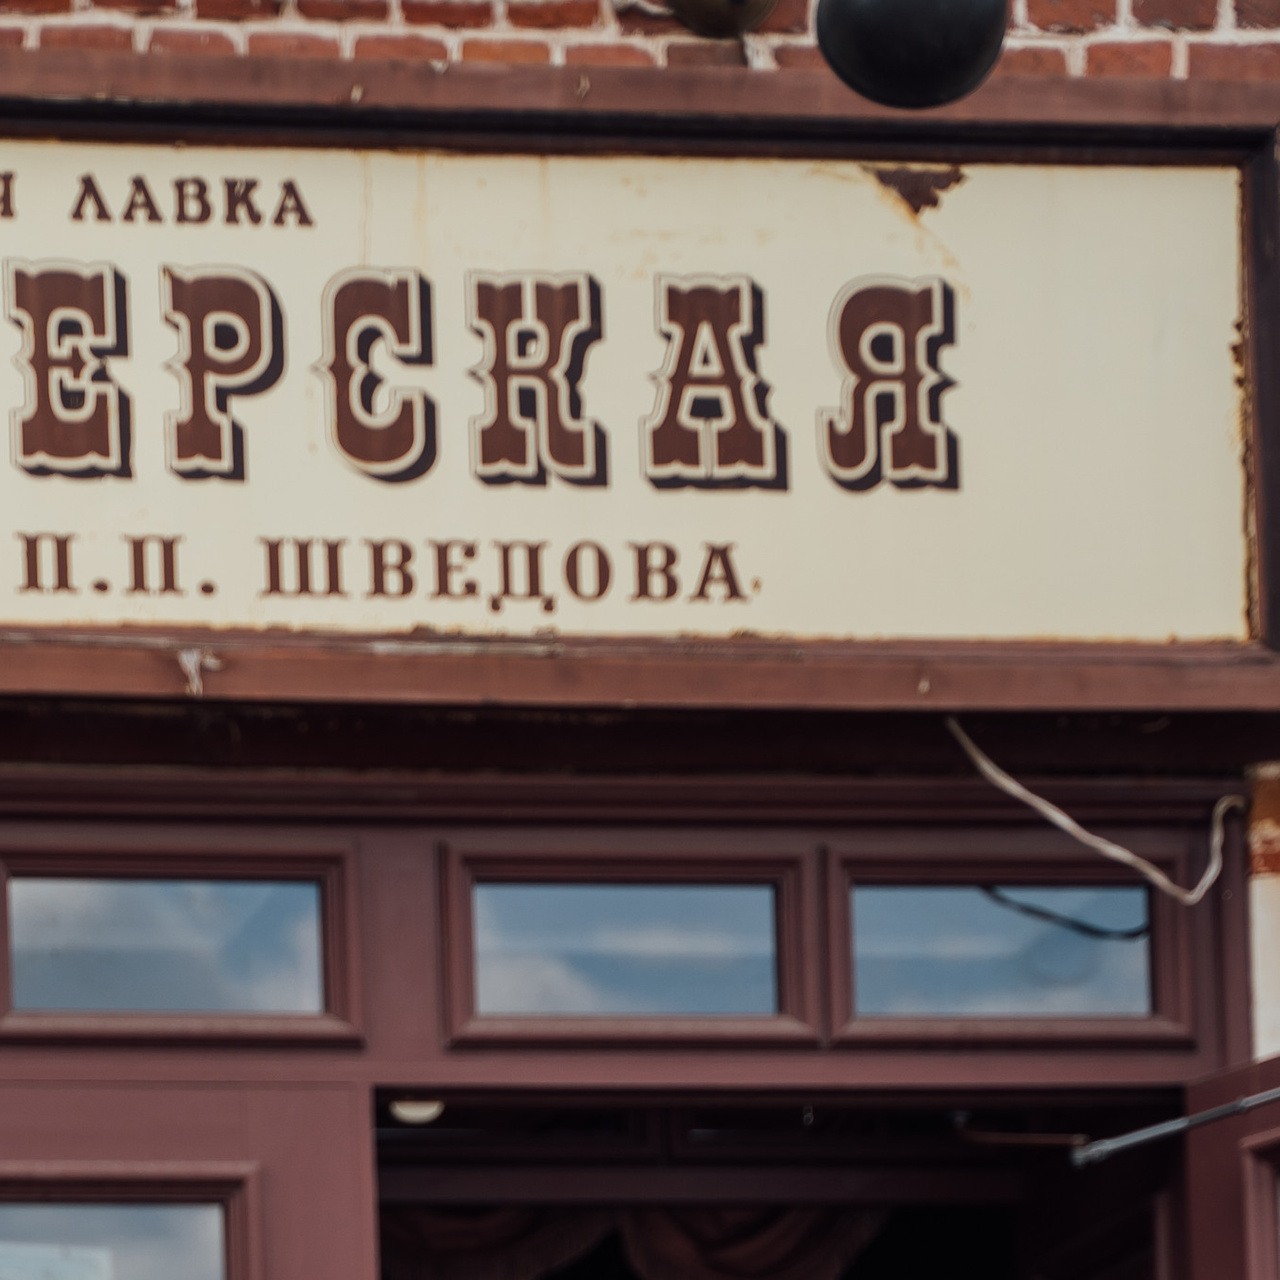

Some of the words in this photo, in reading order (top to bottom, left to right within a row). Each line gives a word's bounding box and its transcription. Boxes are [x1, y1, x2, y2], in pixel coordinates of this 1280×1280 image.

[70, 174, 314, 227] ЛАВКА
[17, 532, 217, 598] П.П.
[259, 537, 753, 614] ШВЕДОВА
